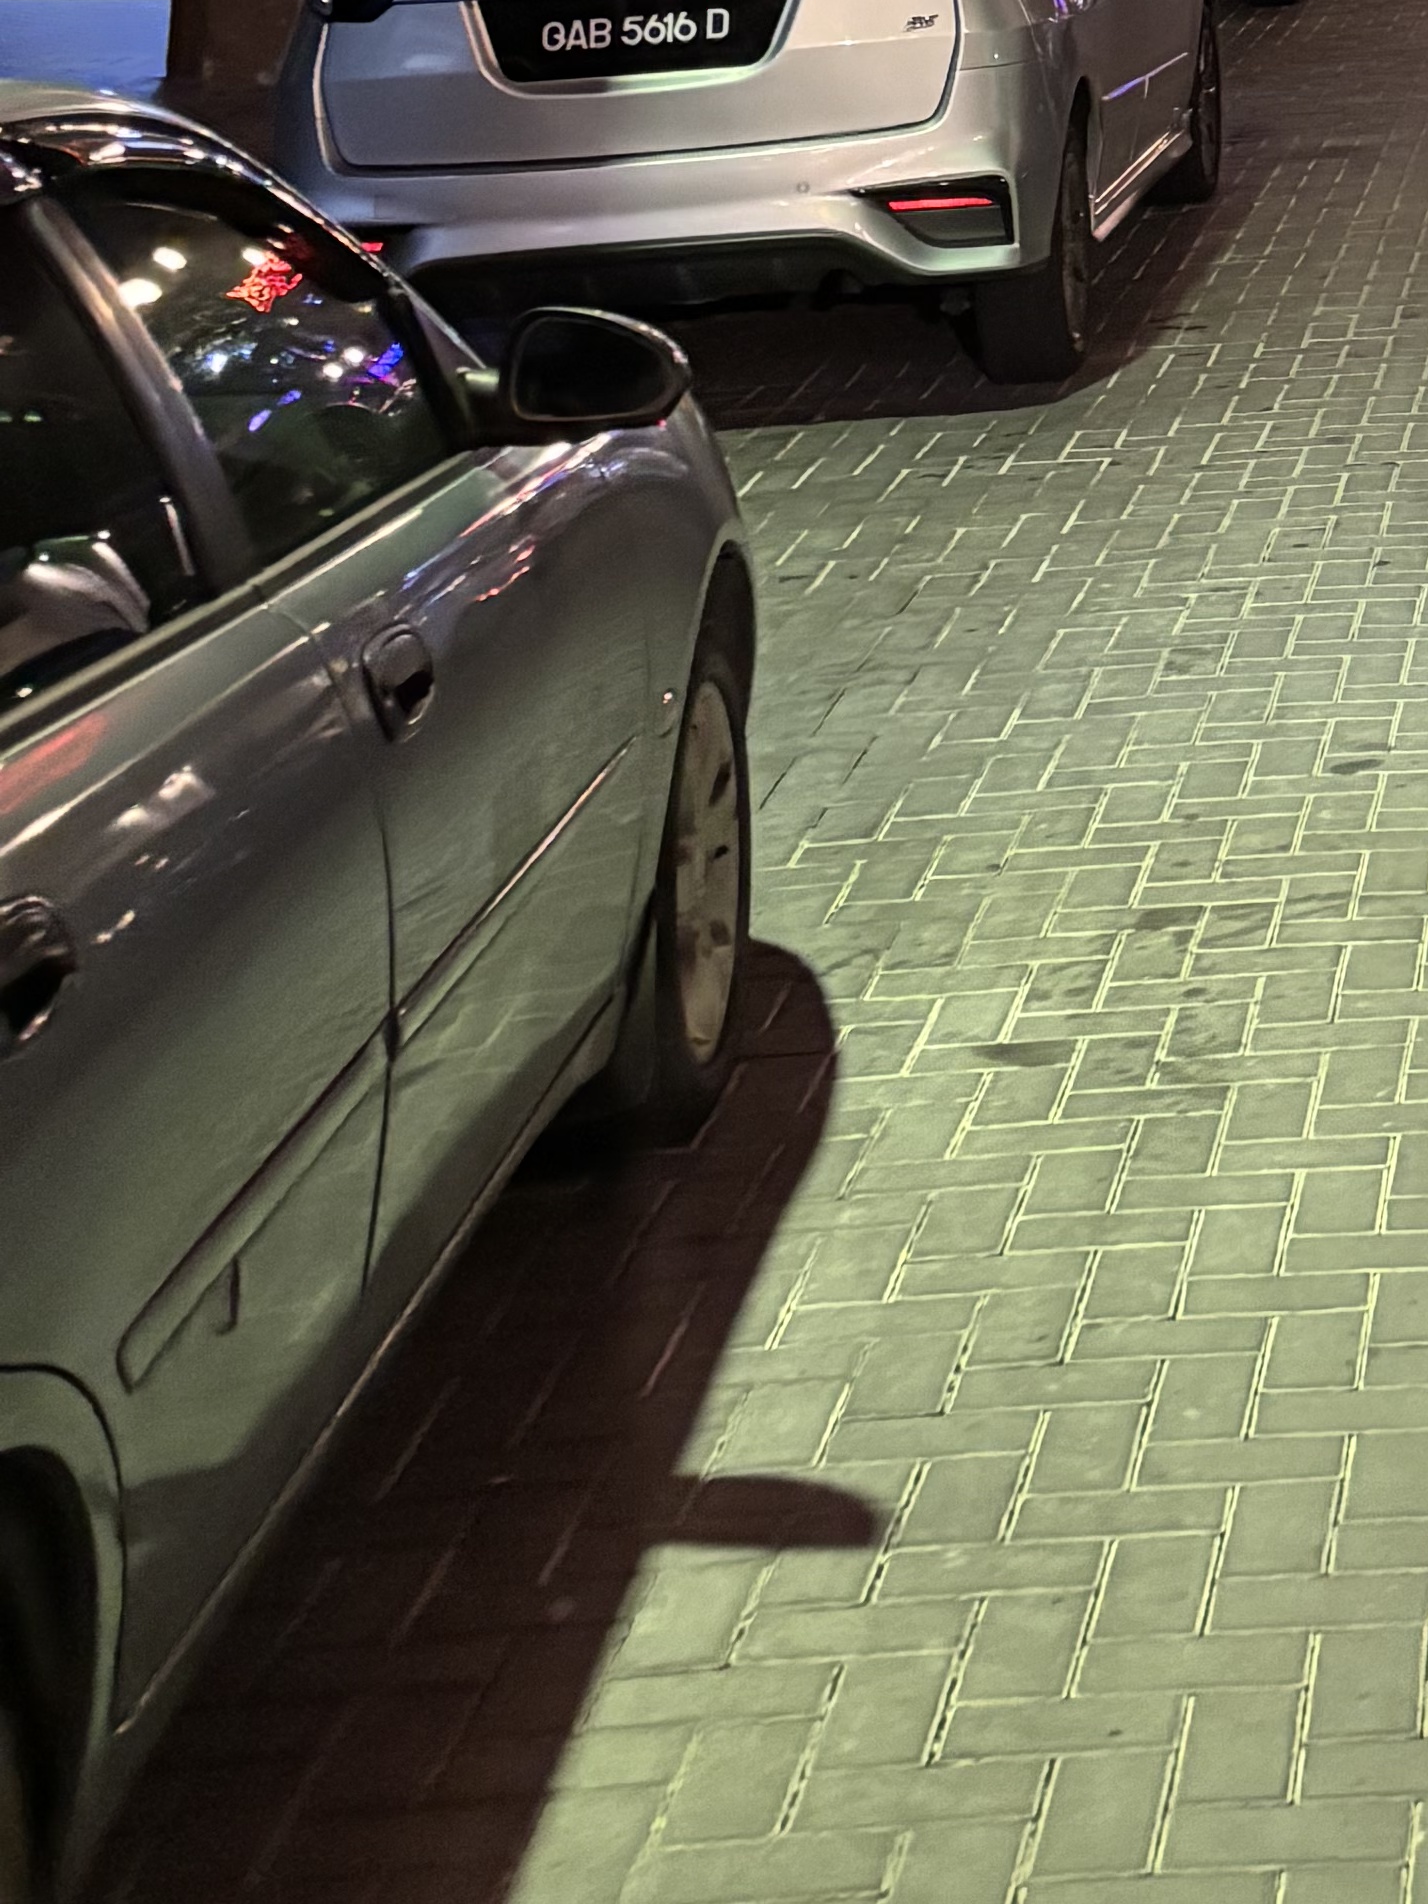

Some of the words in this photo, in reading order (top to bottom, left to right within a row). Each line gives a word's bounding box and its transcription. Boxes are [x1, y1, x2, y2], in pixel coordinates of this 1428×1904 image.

[541, 17, 613, 52] QAB
[620, 10, 698, 46] 5616
[705, 8, 730, 40] D
